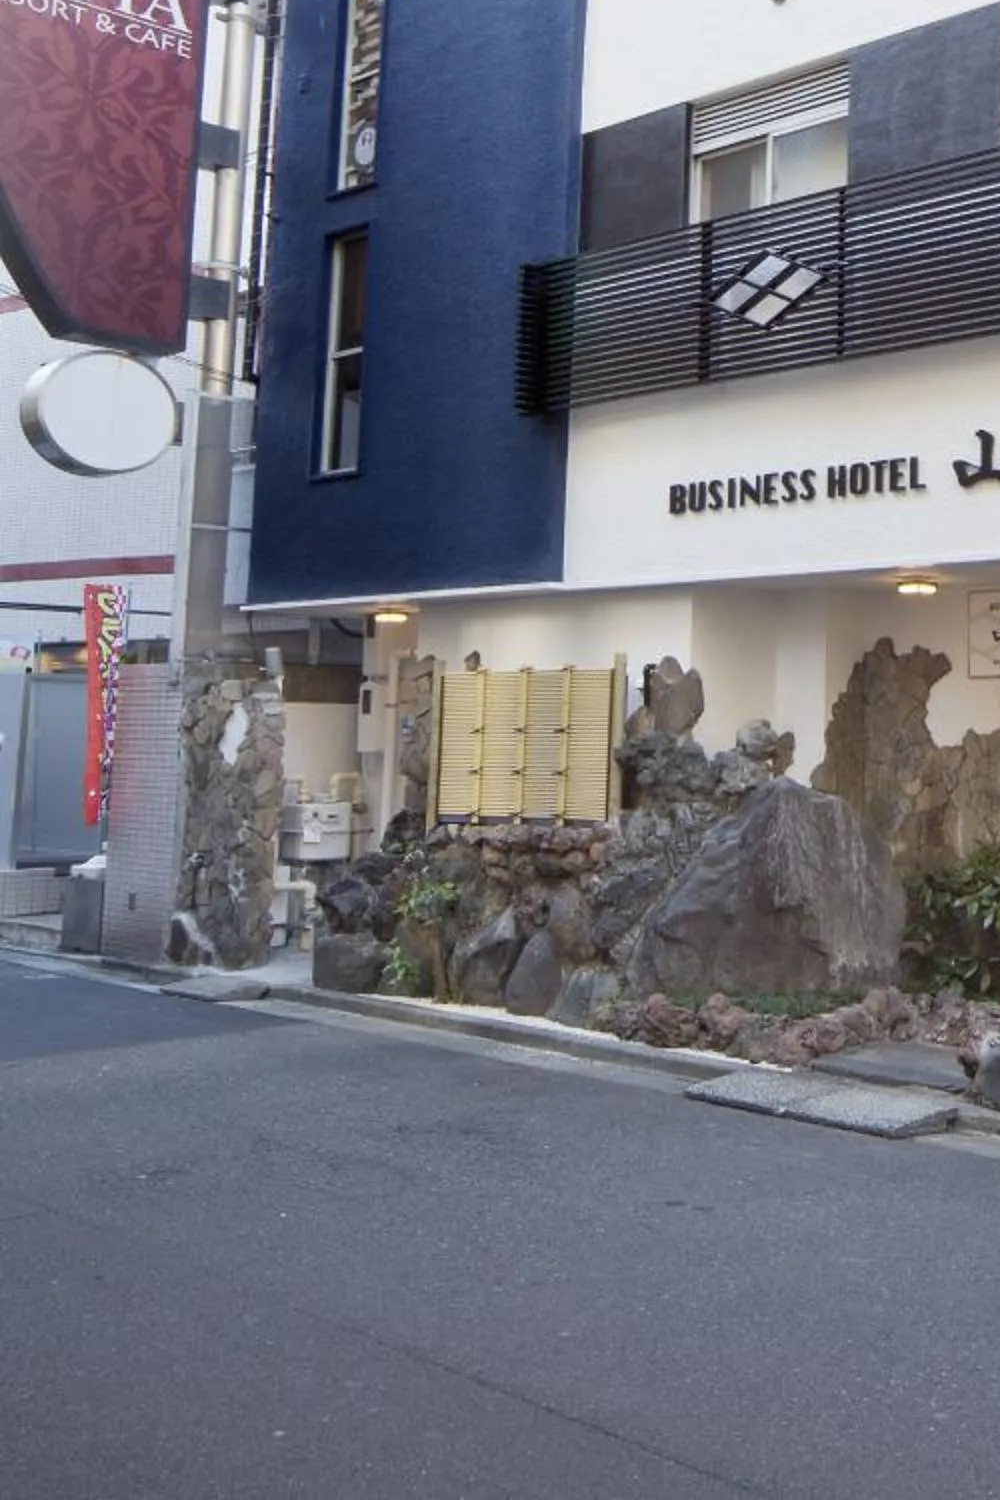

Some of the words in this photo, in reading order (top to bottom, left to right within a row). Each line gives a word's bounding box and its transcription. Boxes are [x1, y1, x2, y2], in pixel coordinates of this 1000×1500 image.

[95, 13, 116, 35] &
[125, 23, 193, 59] CAFE
[669, 468, 818, 516] BUSINESS
[826, 456, 927, 499] HOTEL
